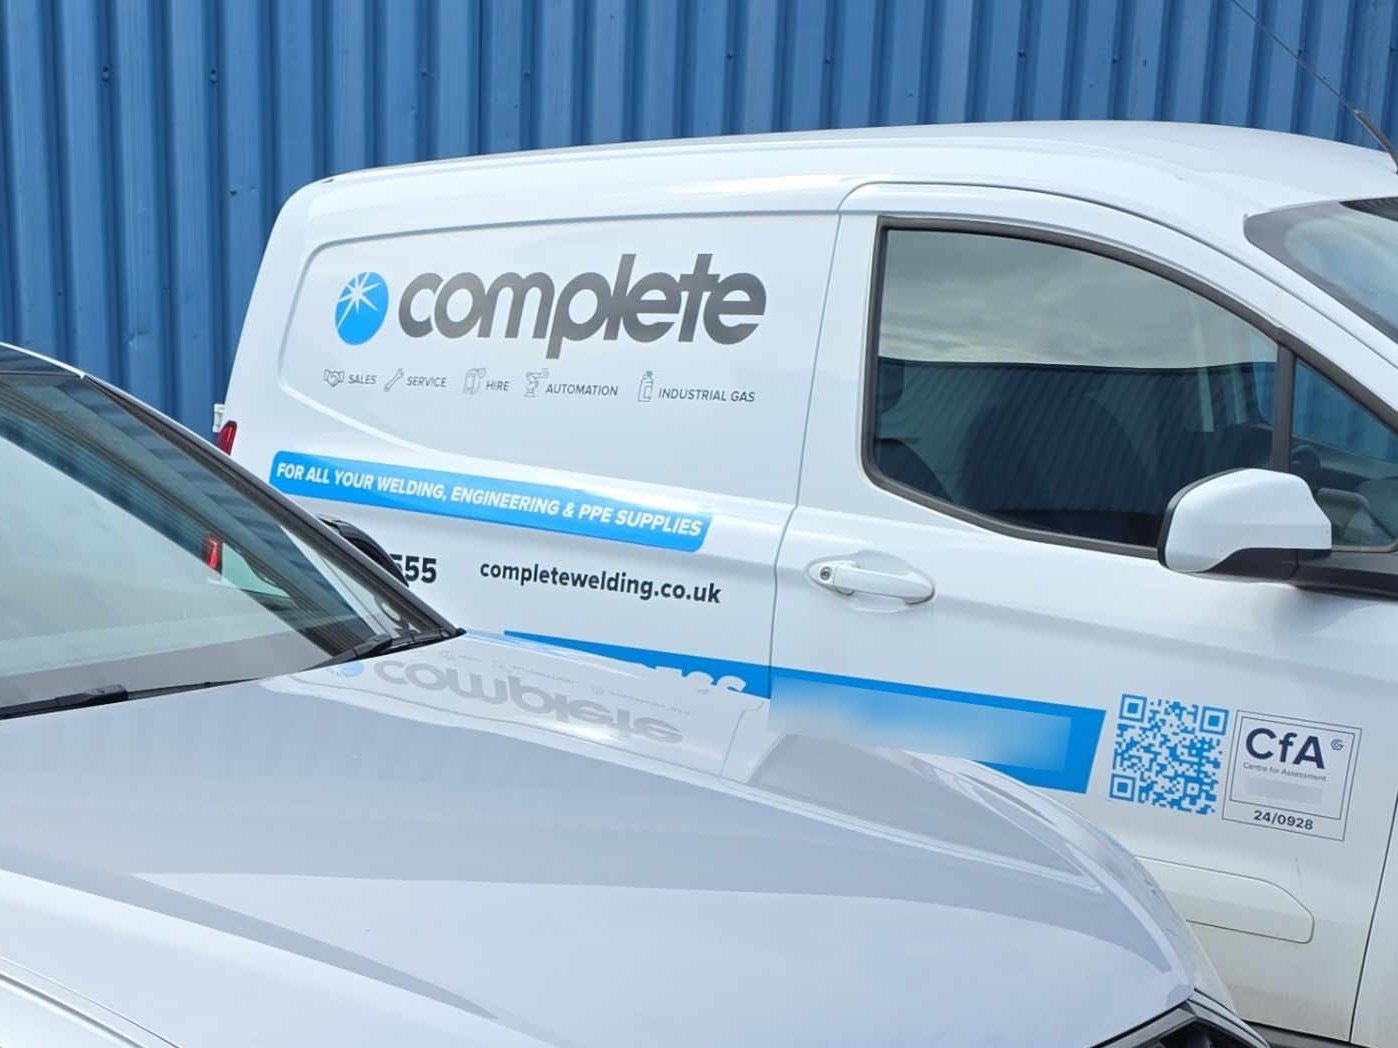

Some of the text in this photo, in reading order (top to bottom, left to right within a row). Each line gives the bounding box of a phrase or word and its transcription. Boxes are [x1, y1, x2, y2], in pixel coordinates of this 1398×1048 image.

[398, 253, 767, 360] complete
[348, 374, 377, 385] SALES
[406, 376, 447, 388] SERVICE
[485, 380, 510, 392] HIRE
[545, 383, 619, 396] AUTOMATION
[658, 387, 755, 403] INDUSTRIAL GAS
[276, 462, 703, 537] FOR ALL YOUR WELDING, ENGINEERING & PPE SUPPLIES
[480, 562, 722, 603] completewelding.co.uk
[1245, 727, 1325, 769] CfA
[1243, 762, 1327, 782] Centre for Assessment
[1254, 810, 1314, 830] 24/0928
